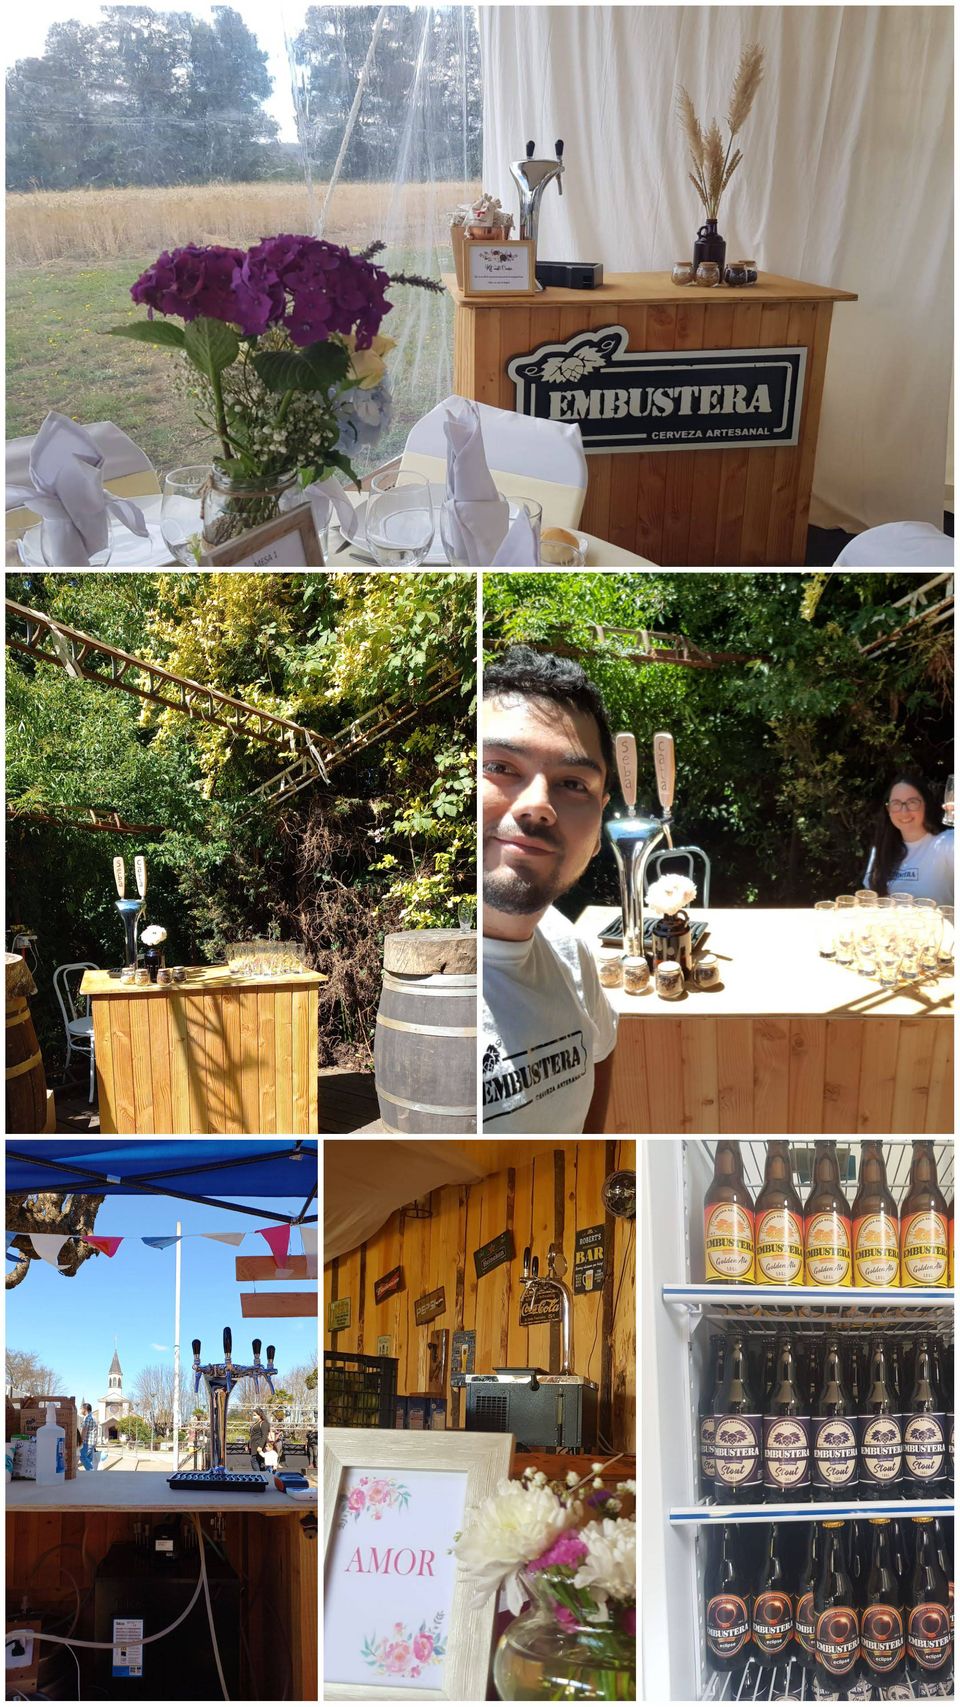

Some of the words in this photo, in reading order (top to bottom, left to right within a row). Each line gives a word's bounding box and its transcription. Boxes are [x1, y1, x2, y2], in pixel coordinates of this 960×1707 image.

[548, 384, 772, 420] EMBUSTERA
[651, 430, 703, 440] CERVEZA
[705, 427, 771, 438] ARTESANAL
[483, 1046, 581, 1106] EMBUSTERA
[757, 1243, 803, 1255] EMBUSER
[575, 1246, 604, 1265] BAR
[715, 1256, 736, 1266] Golden
[765, 1262, 786, 1271] Golden
[813, 1265, 833, 1275] Golden
[864, 1266, 885, 1276] Golden
[912, 1263, 934, 1273] Golden
[860, 1445, 902, 1456] EMBUSTE
[720, 1464, 746, 1476] Stout
[825, 1465, 850, 1477] Stout
[873, 1462, 896, 1474] Stout
[911, 1460, 935, 1471] Stout
[774, 1466, 800, 1478] Stout
[345, 1547, 436, 1577] AMOR
